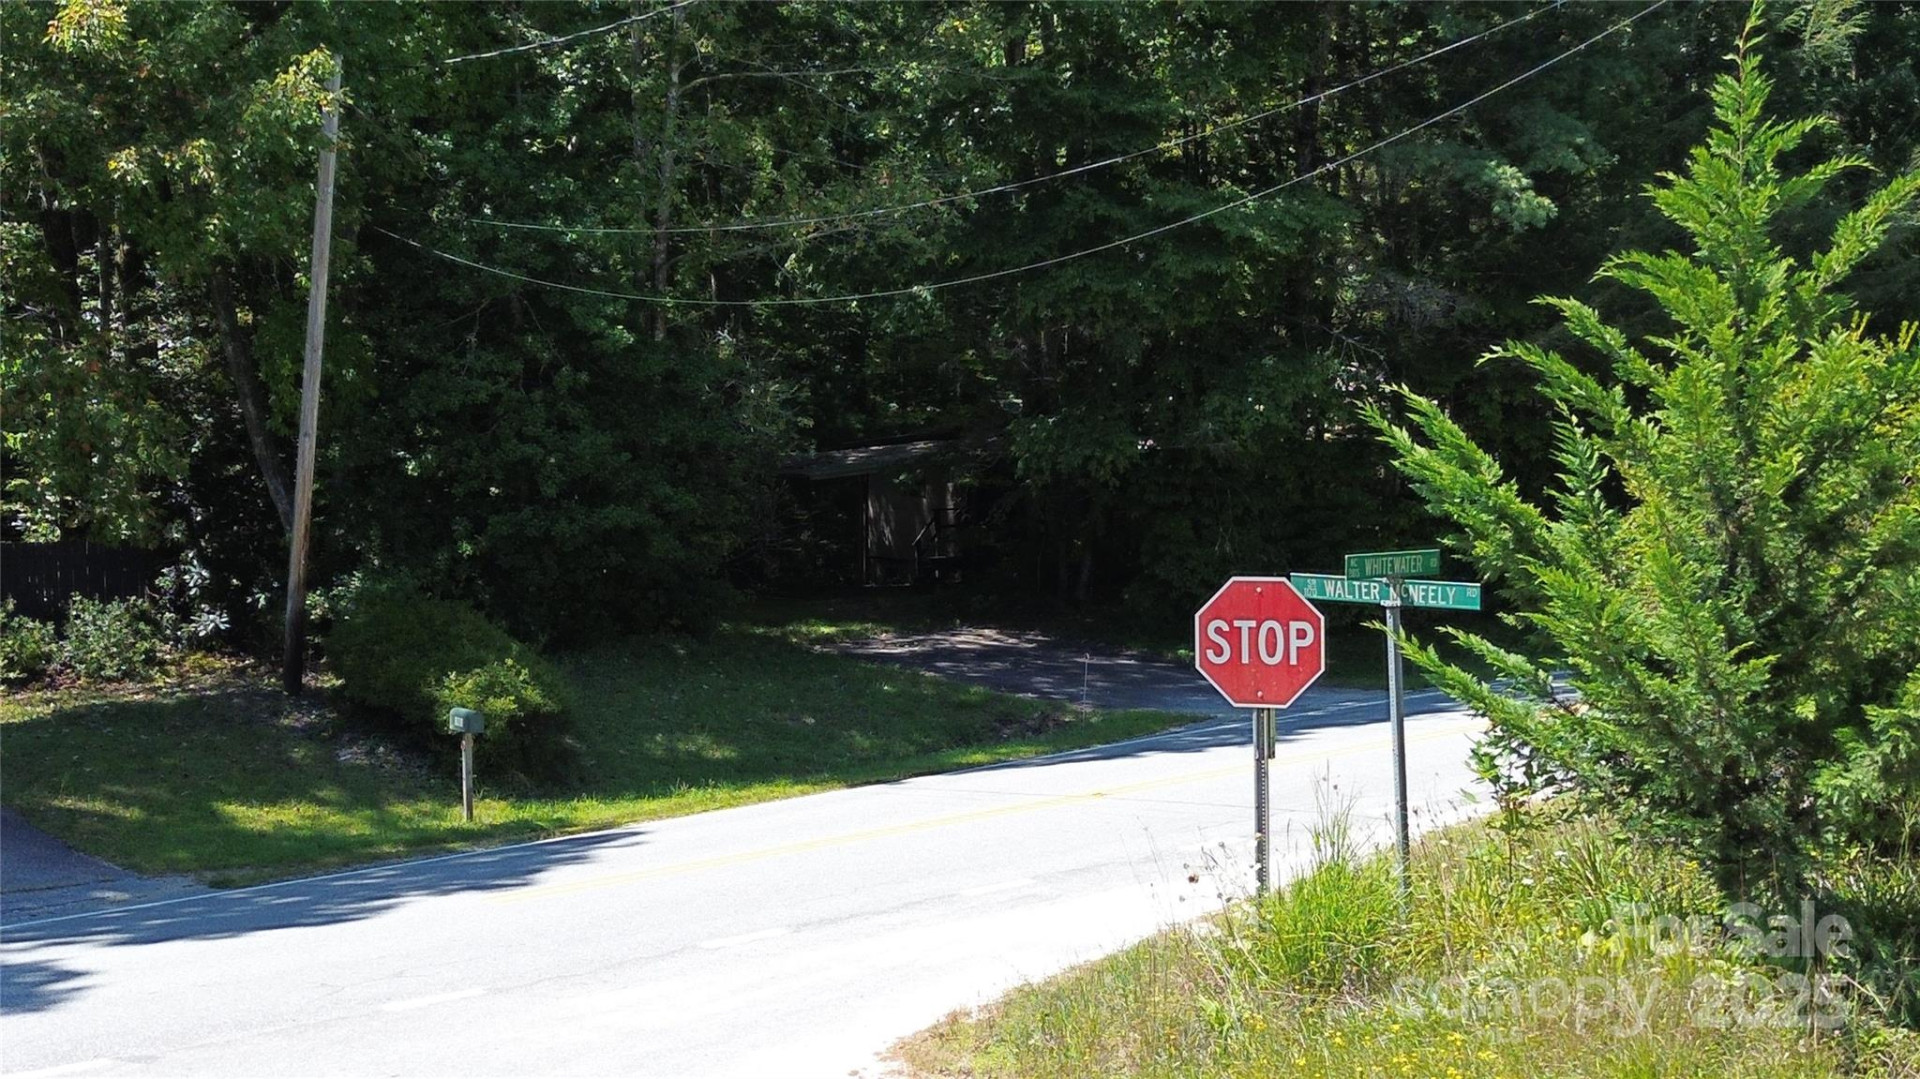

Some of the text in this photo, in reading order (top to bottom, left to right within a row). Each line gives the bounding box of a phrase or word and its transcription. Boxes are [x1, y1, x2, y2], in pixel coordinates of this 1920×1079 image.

[1365, 555, 1423, 576] WHITEWATER
[1324, 580, 1380, 600] WALTER
[1466, 589, 1478, 597] RD
[1206, 619, 1315, 666] STOP
